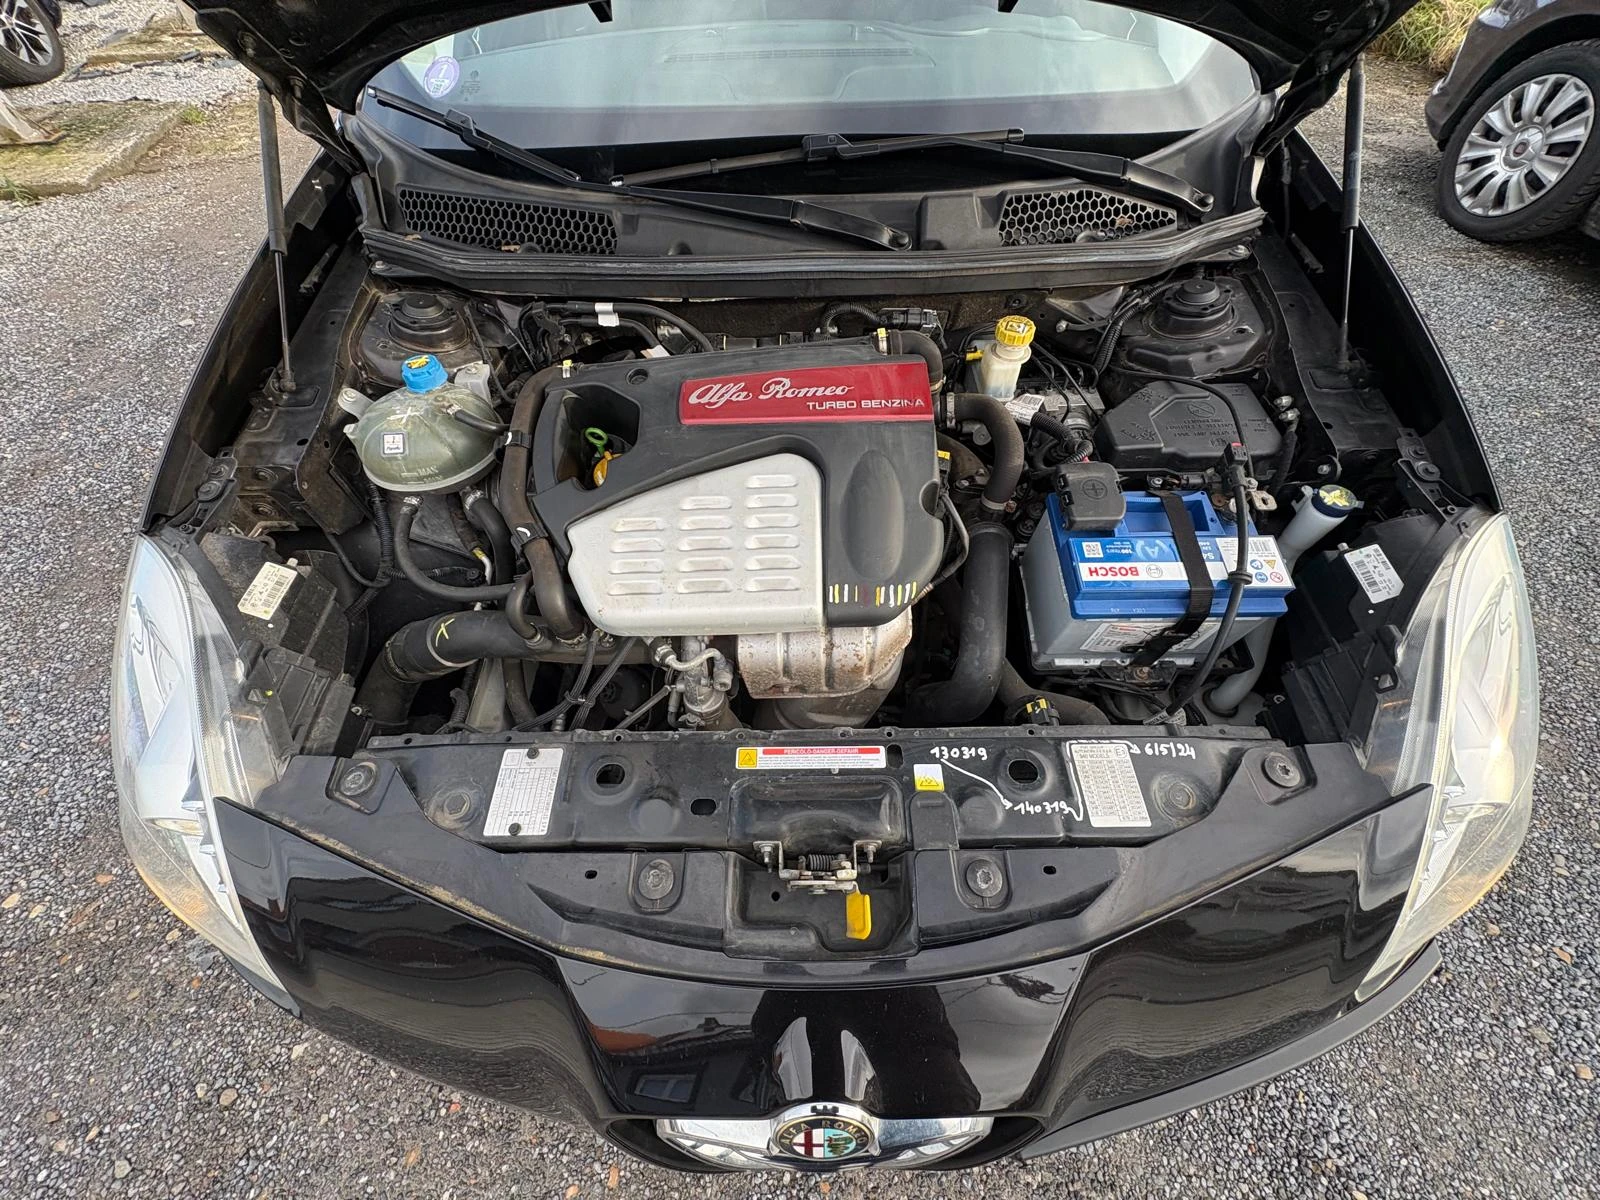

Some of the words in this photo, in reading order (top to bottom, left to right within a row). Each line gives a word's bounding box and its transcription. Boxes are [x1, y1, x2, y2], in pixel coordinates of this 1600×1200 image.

[688, 382, 752, 409] Alfa
[758, 377, 854, 399] Romeo
[806, 400, 857, 411] TURBO
[861, 398, 925, 409] BENZINA
[1088, 566, 1140, 578] BOSCH
[930, 746, 988, 760] 130319
[1014, 800, 1071, 816] 140319
[780, 1122, 810, 1145] ALFA
[821, 1119, 868, 1144] ROMEO
